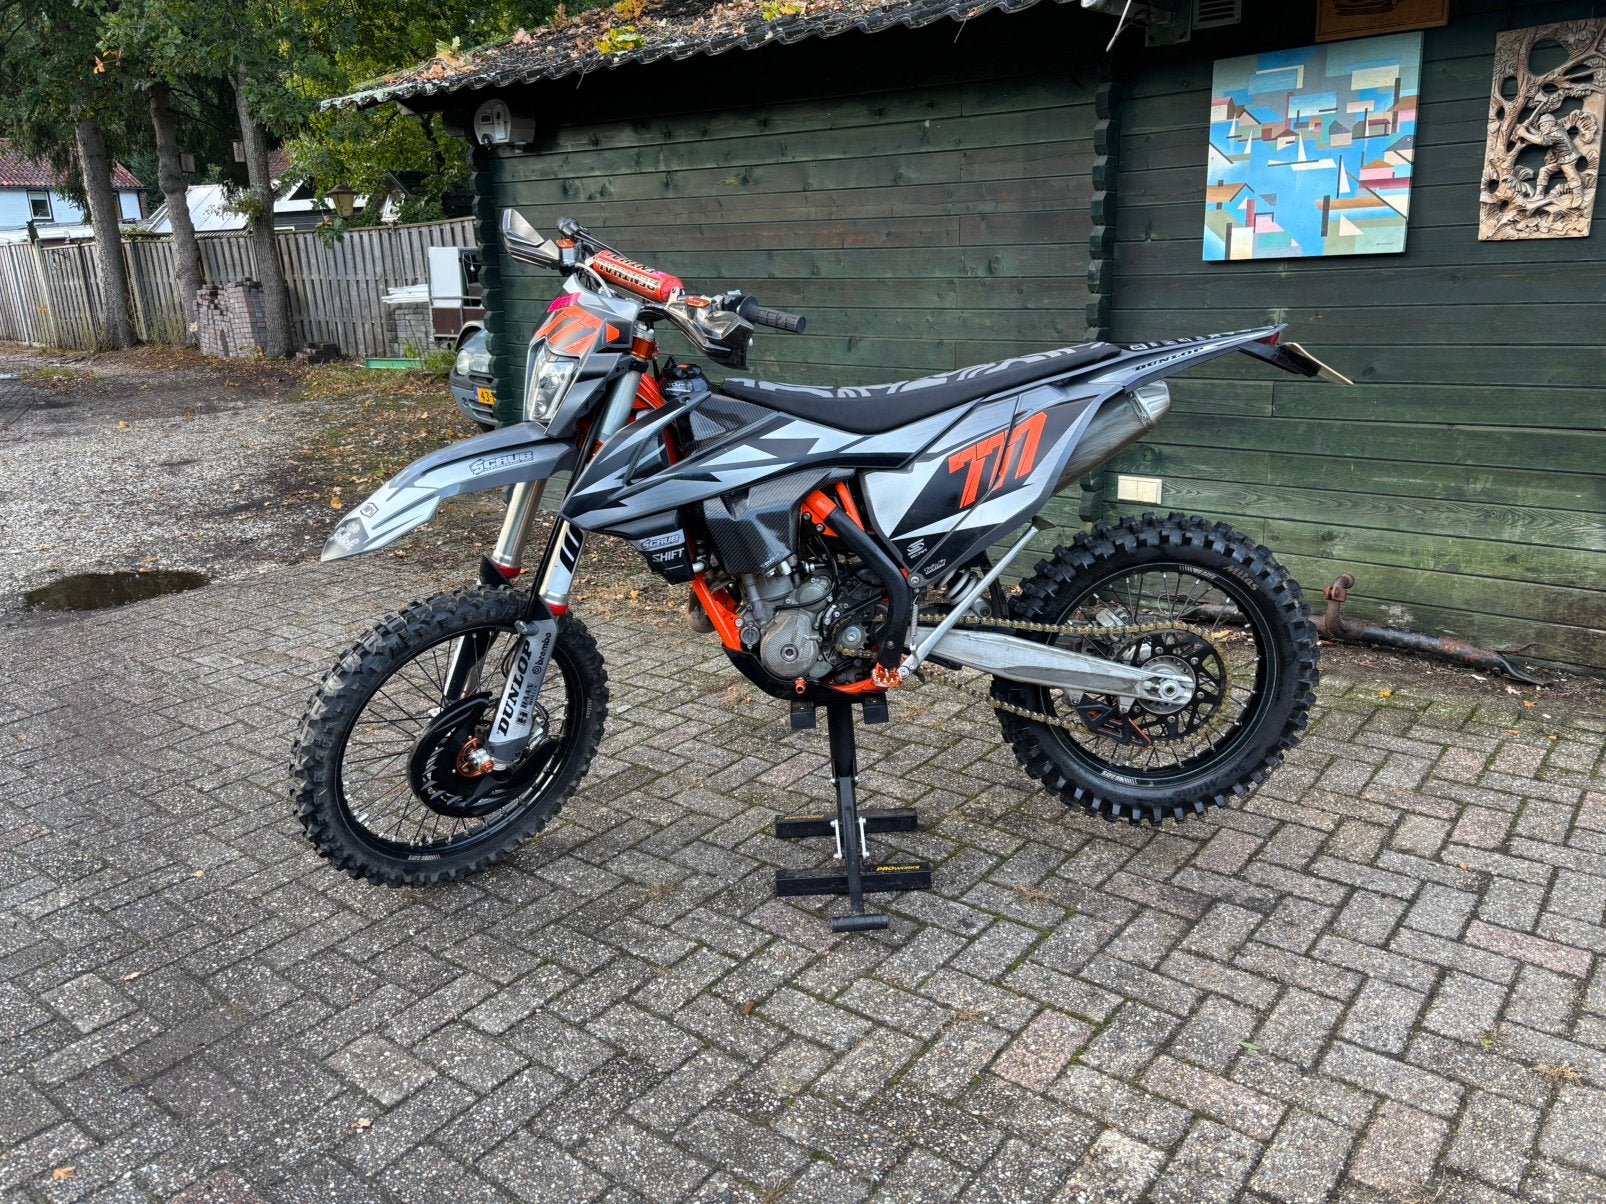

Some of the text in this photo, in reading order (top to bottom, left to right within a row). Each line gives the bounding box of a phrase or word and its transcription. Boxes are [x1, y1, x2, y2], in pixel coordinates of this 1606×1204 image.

[1133, 346, 1205, 372] DUNLOP
[641, 533, 681, 551] SCRUB
[652, 547, 685, 562] SHIFT
[1222, 565, 1259, 591] Mitas
[535, 632, 551, 666] brembo
[498, 640, 532, 737] DUNLOP
[521, 682, 534, 708] HAAN
